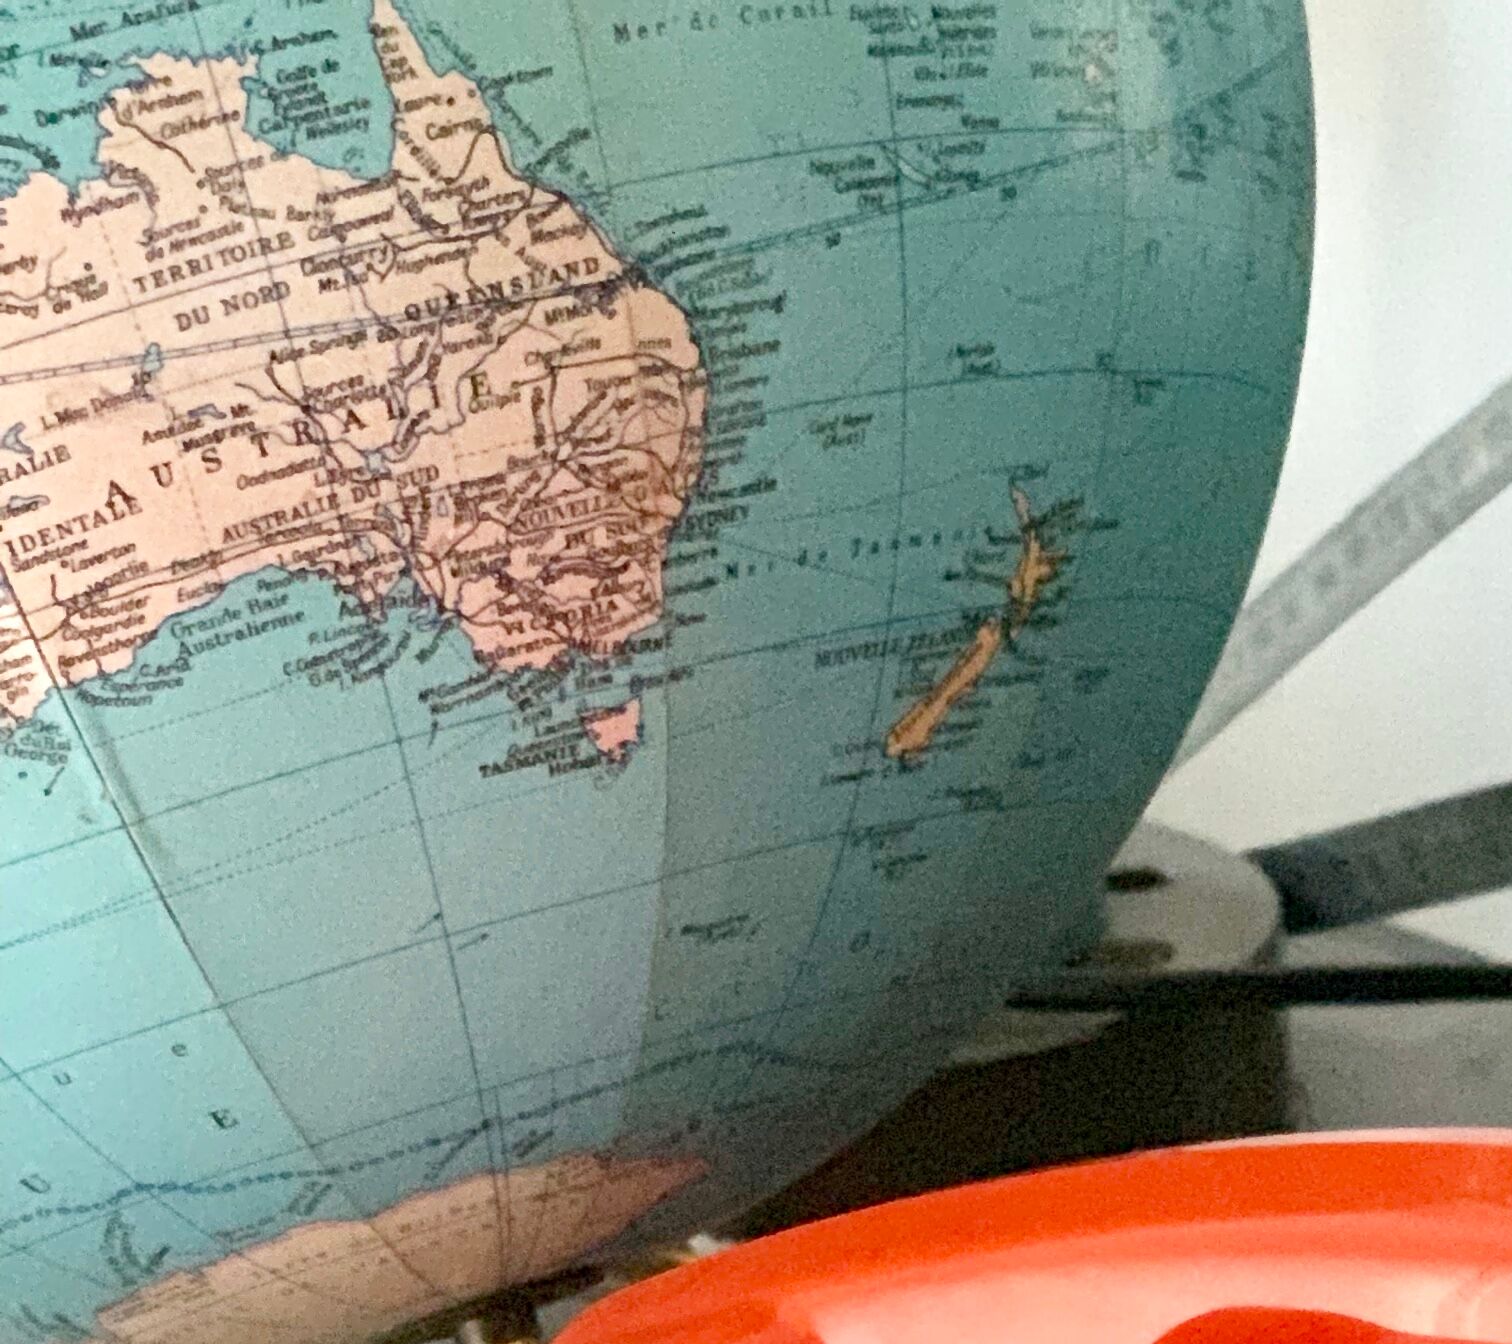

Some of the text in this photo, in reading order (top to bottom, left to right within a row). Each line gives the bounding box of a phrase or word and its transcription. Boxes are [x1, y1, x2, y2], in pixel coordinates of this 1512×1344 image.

[612, 20, 668, 43] Mer
[739, 1, 835, 25] Corail
[132, 231, 296, 294] TERRITOIRE
[174, 280, 291, 332] DU NORD
[222, 493, 341, 544] AUSTRALIE
[350, 481, 380, 503] DU
[396, 464, 440, 490] SUD
[170, 607, 243, 640] Grande
[178, 610, 306, 660] Australienne
